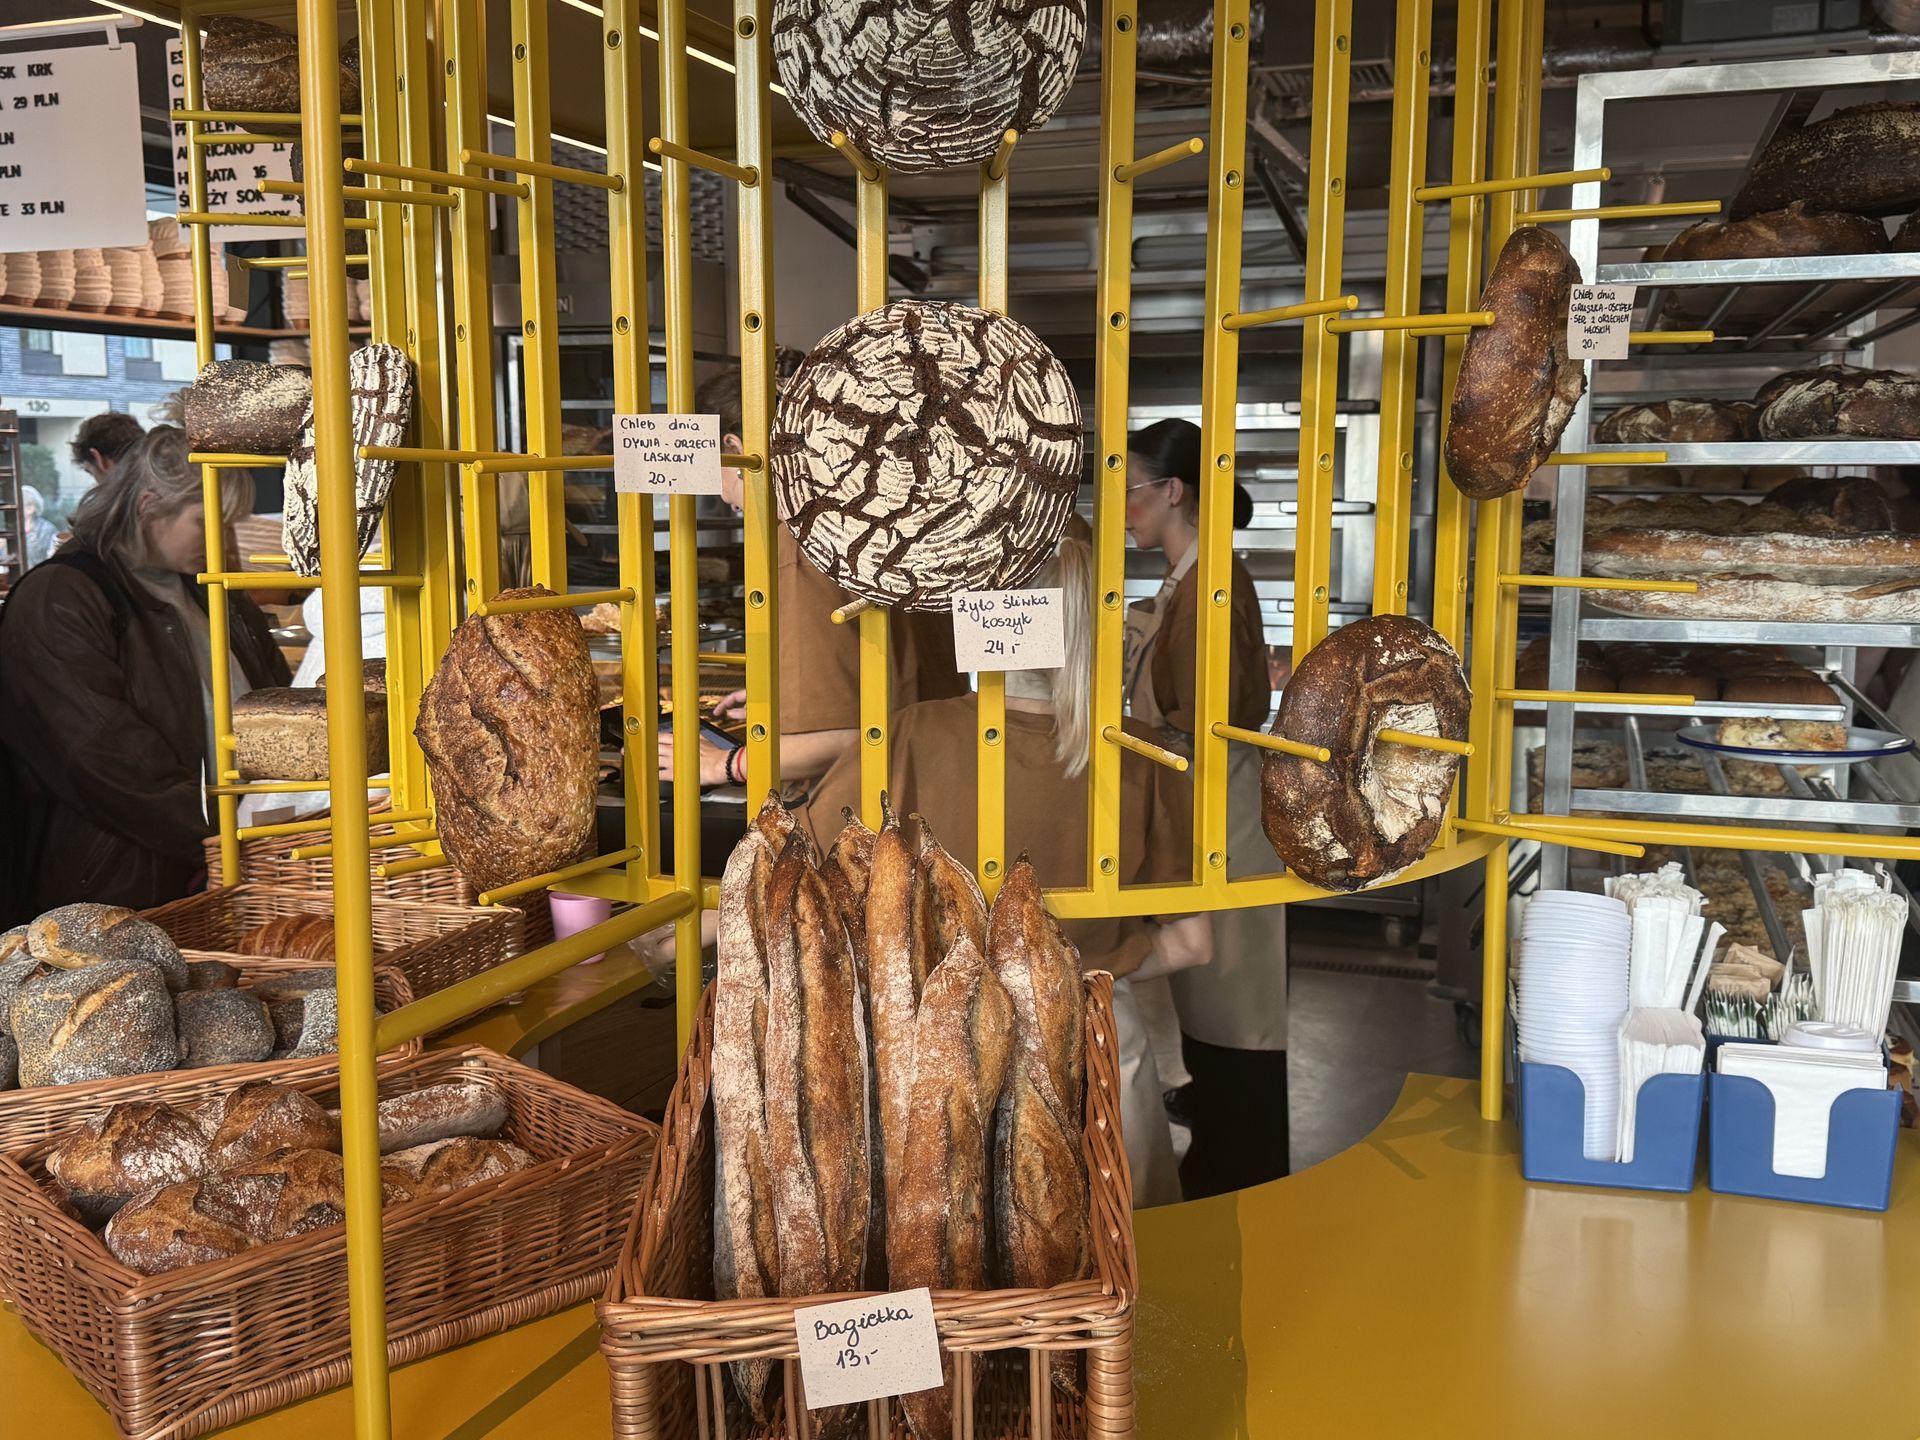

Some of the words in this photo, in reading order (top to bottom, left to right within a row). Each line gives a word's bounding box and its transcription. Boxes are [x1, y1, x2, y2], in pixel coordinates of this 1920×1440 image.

[27, 62, 54, 77] KRK
[13, 95, 28, 110] 29
[33, 91, 60, 108] PLN
[21, 202, 36, 216] 33
[40, 200, 65, 215] PLN
[1573, 288, 1594, 301] Chleb
[1596, 288, 1616, 301] dnia
[27, 399, 50, 413] 130
[620, 417, 656, 431] Chleb
[668, 417, 700, 431] dnia
[622, 437, 661, 449] DYNIA
[673, 438, 717, 449] ORZECH
[643, 451, 695, 465] LASKOWY
[1002, 593, 1050, 610] śliwka
[982, 611, 1033, 636] koszyk
[813, 1306, 914, 1348] Bagietka
